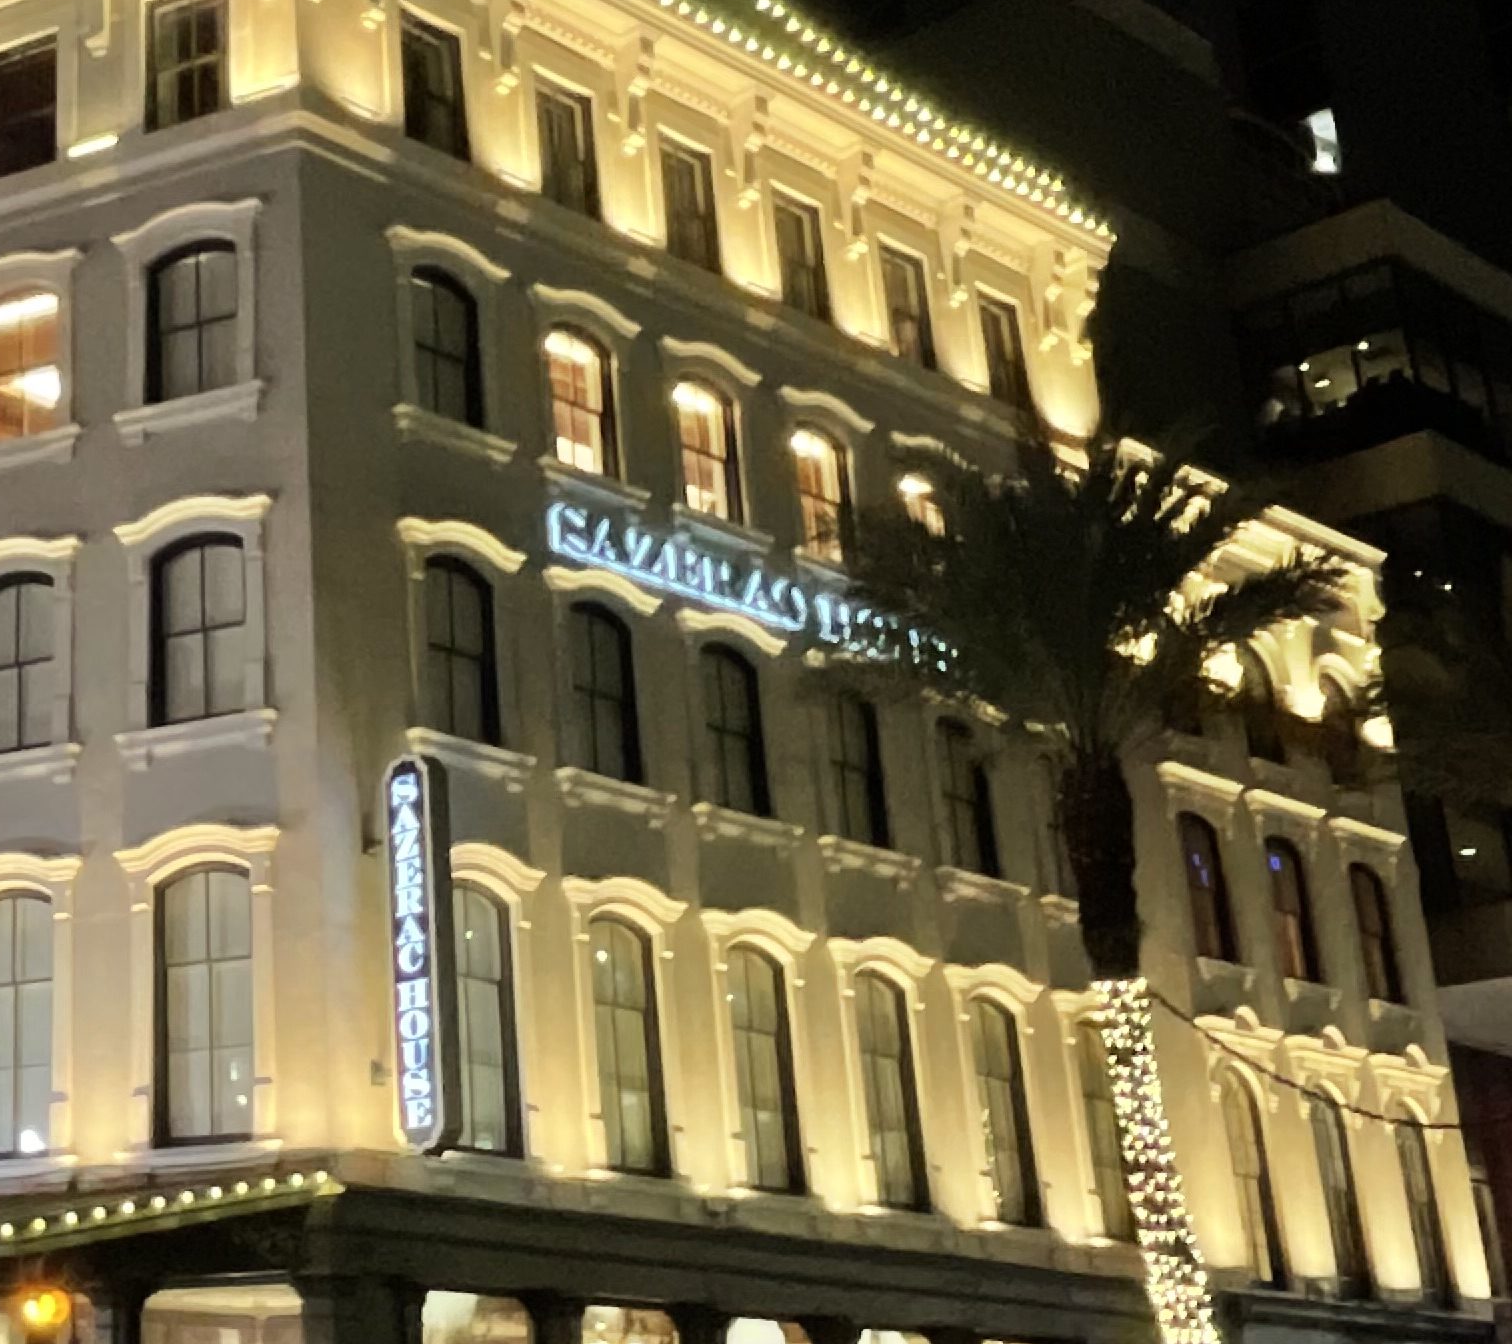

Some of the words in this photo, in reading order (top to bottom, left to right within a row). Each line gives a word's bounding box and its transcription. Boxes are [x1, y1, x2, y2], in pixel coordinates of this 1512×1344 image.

[545, 501, 808, 633] SAZERAC
[390, 772, 425, 974] SAZERAC
[395, 977, 433, 1130] HOUSE
